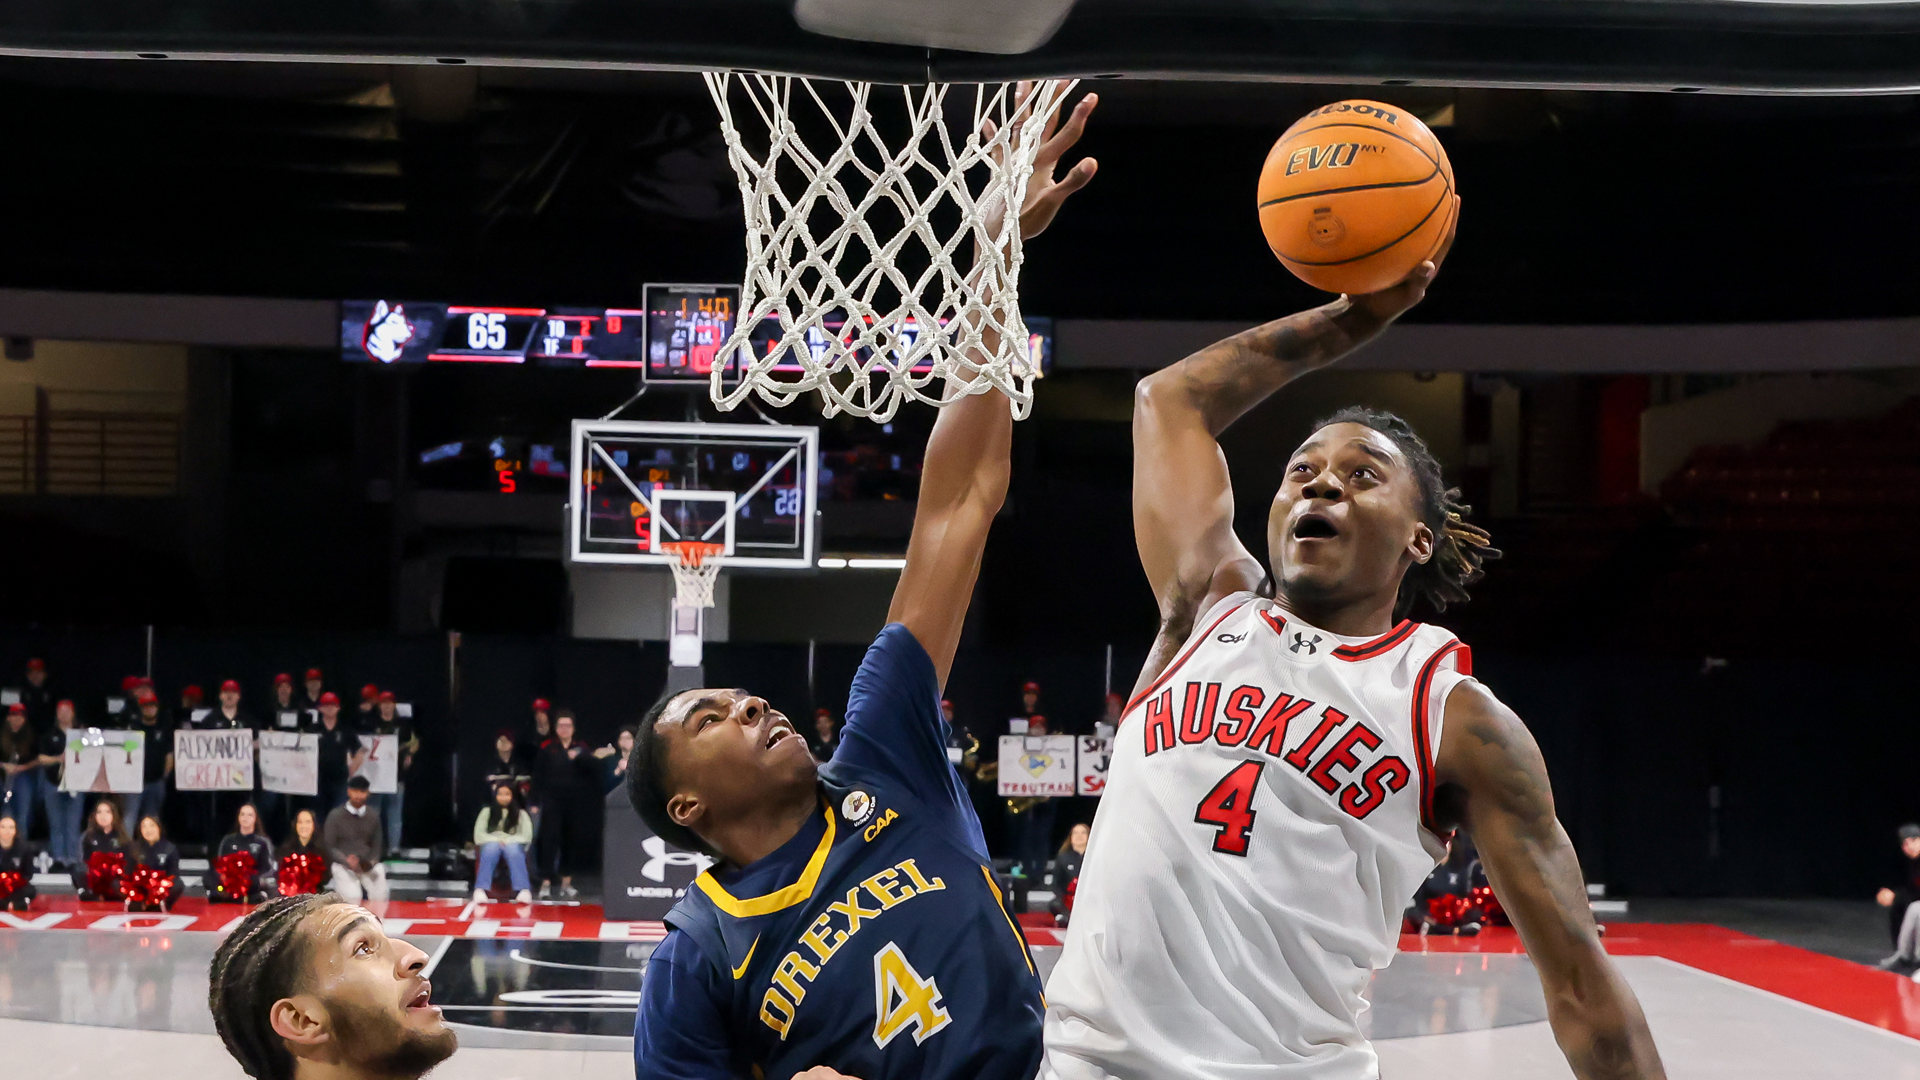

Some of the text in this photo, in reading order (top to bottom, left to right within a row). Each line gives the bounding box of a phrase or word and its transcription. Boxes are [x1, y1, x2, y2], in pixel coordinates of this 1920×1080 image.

[1285, 143, 1387, 177] EVO NXT
[467, 313, 506, 349] 65
[177, 735, 252, 760] ALEXANDER
[1144, 682, 1411, 820] HUSKIES
[184, 763, 232, 788] GREAT
[1002, 782, 1074, 794] TROUTMAN
[864, 808, 900, 843] CAA
[1194, 759, 1266, 858] 4
[626, 886, 674, 898] UNDER
[760, 858, 947, 1041] DREXEL
[872, 940, 953, 1050] 4
